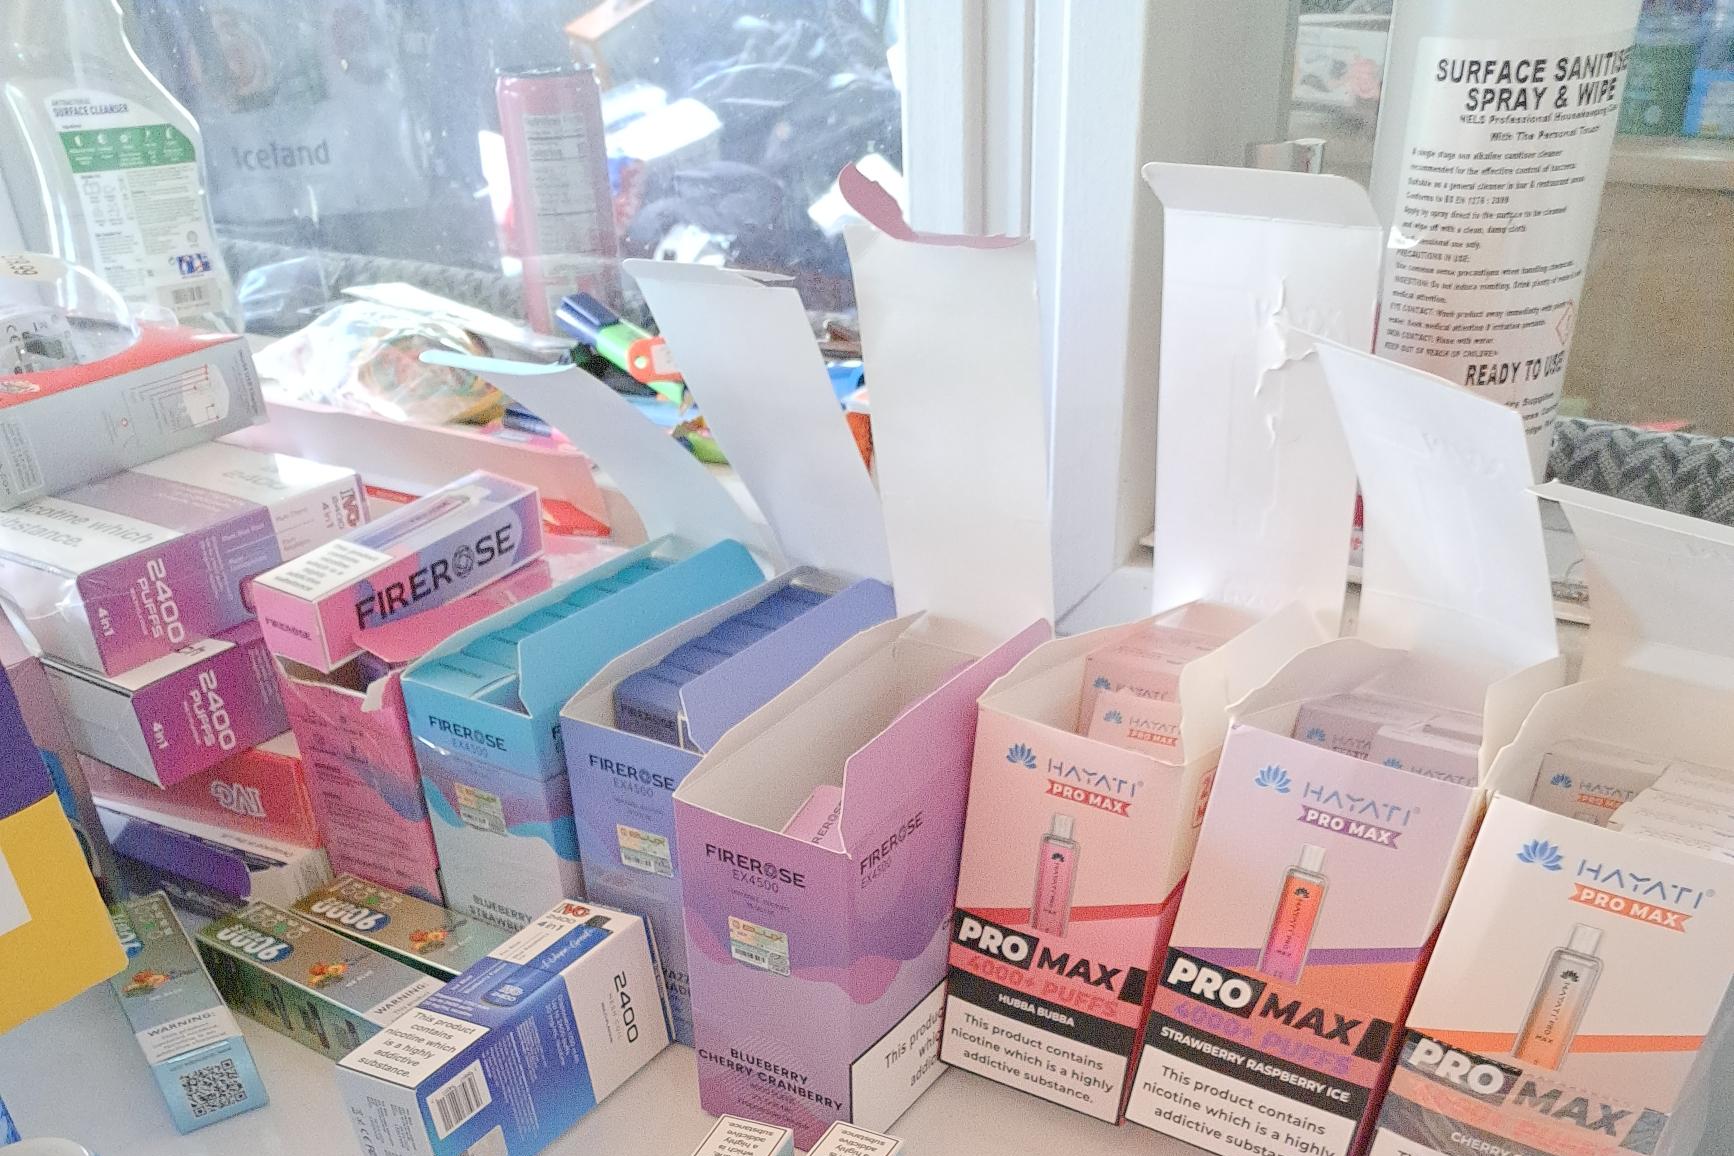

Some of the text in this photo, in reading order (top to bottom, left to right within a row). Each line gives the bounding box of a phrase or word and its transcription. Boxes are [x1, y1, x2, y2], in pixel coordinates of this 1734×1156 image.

[1436, 58, 1548, 84] SURFACE
[1465, 77, 1617, 111] SPRAY & WIPE
[53, 105, 89, 118] SURFACE
[1465, 351, 1565, 386] READY TO USE
[91, 520, 154, 544] which
[146, 557, 185, 644] 2400
[355, 524, 516, 631] FIREROSE
[137, 577, 163, 639] PUFFS
[190, 690, 215, 747] PUFFS
[199, 669, 236, 751] 2400
[428, 715, 507, 752] FIREROSE
[589, 754, 675, 792] FIREROSE
[1048, 758, 1137, 798] HAYATI
[210, 779, 266, 818] IVG
[1052, 783, 1125, 814] PRO MAX
[1303, 781, 1412, 826] HAYATI
[859, 811, 924, 875] FIREROSE
[1306, 809, 1391, 845] PRO MAX
[705, 843, 806, 888] FIREROSE
[732, 869, 779, 894] EX4500
[1577, 859, 1703, 909] HAYATI
[1580, 888, 1679, 927] PRO MAX
[958, 917, 1123, 992] PRO MAX
[612, 969, 640, 1045] 2400
[998, 993, 1075, 1027] HUBBA BUBBA
[1167, 957, 1362, 1046] PRO MAX
[951, 1026, 1114, 1094] nicotine which is a highly
[964, 1013, 1104, 1071] This product contains
[1160, 1026, 1352, 1103] STRAWBERRY RASPBERRY ICE
[699, 1049, 753, 1077] CHERRY
[757, 1071, 843, 1111] CRANBERRY
[729, 1048, 808, 1085] BLUEBERRY
[963, 1050, 1094, 1103] addictive substance.
[1407, 1037, 1633, 1137] PRO MAX
[1142, 1080, 1201, 1112] nicotine
[1205, 1106, 1251, 1131] which
[1255, 1121, 1267, 1137] is
[1271, 1129, 1280, 1140] a
[1153, 1106, 1223, 1140] addictive
[1161, 1065, 1326, 1136] This product contains
